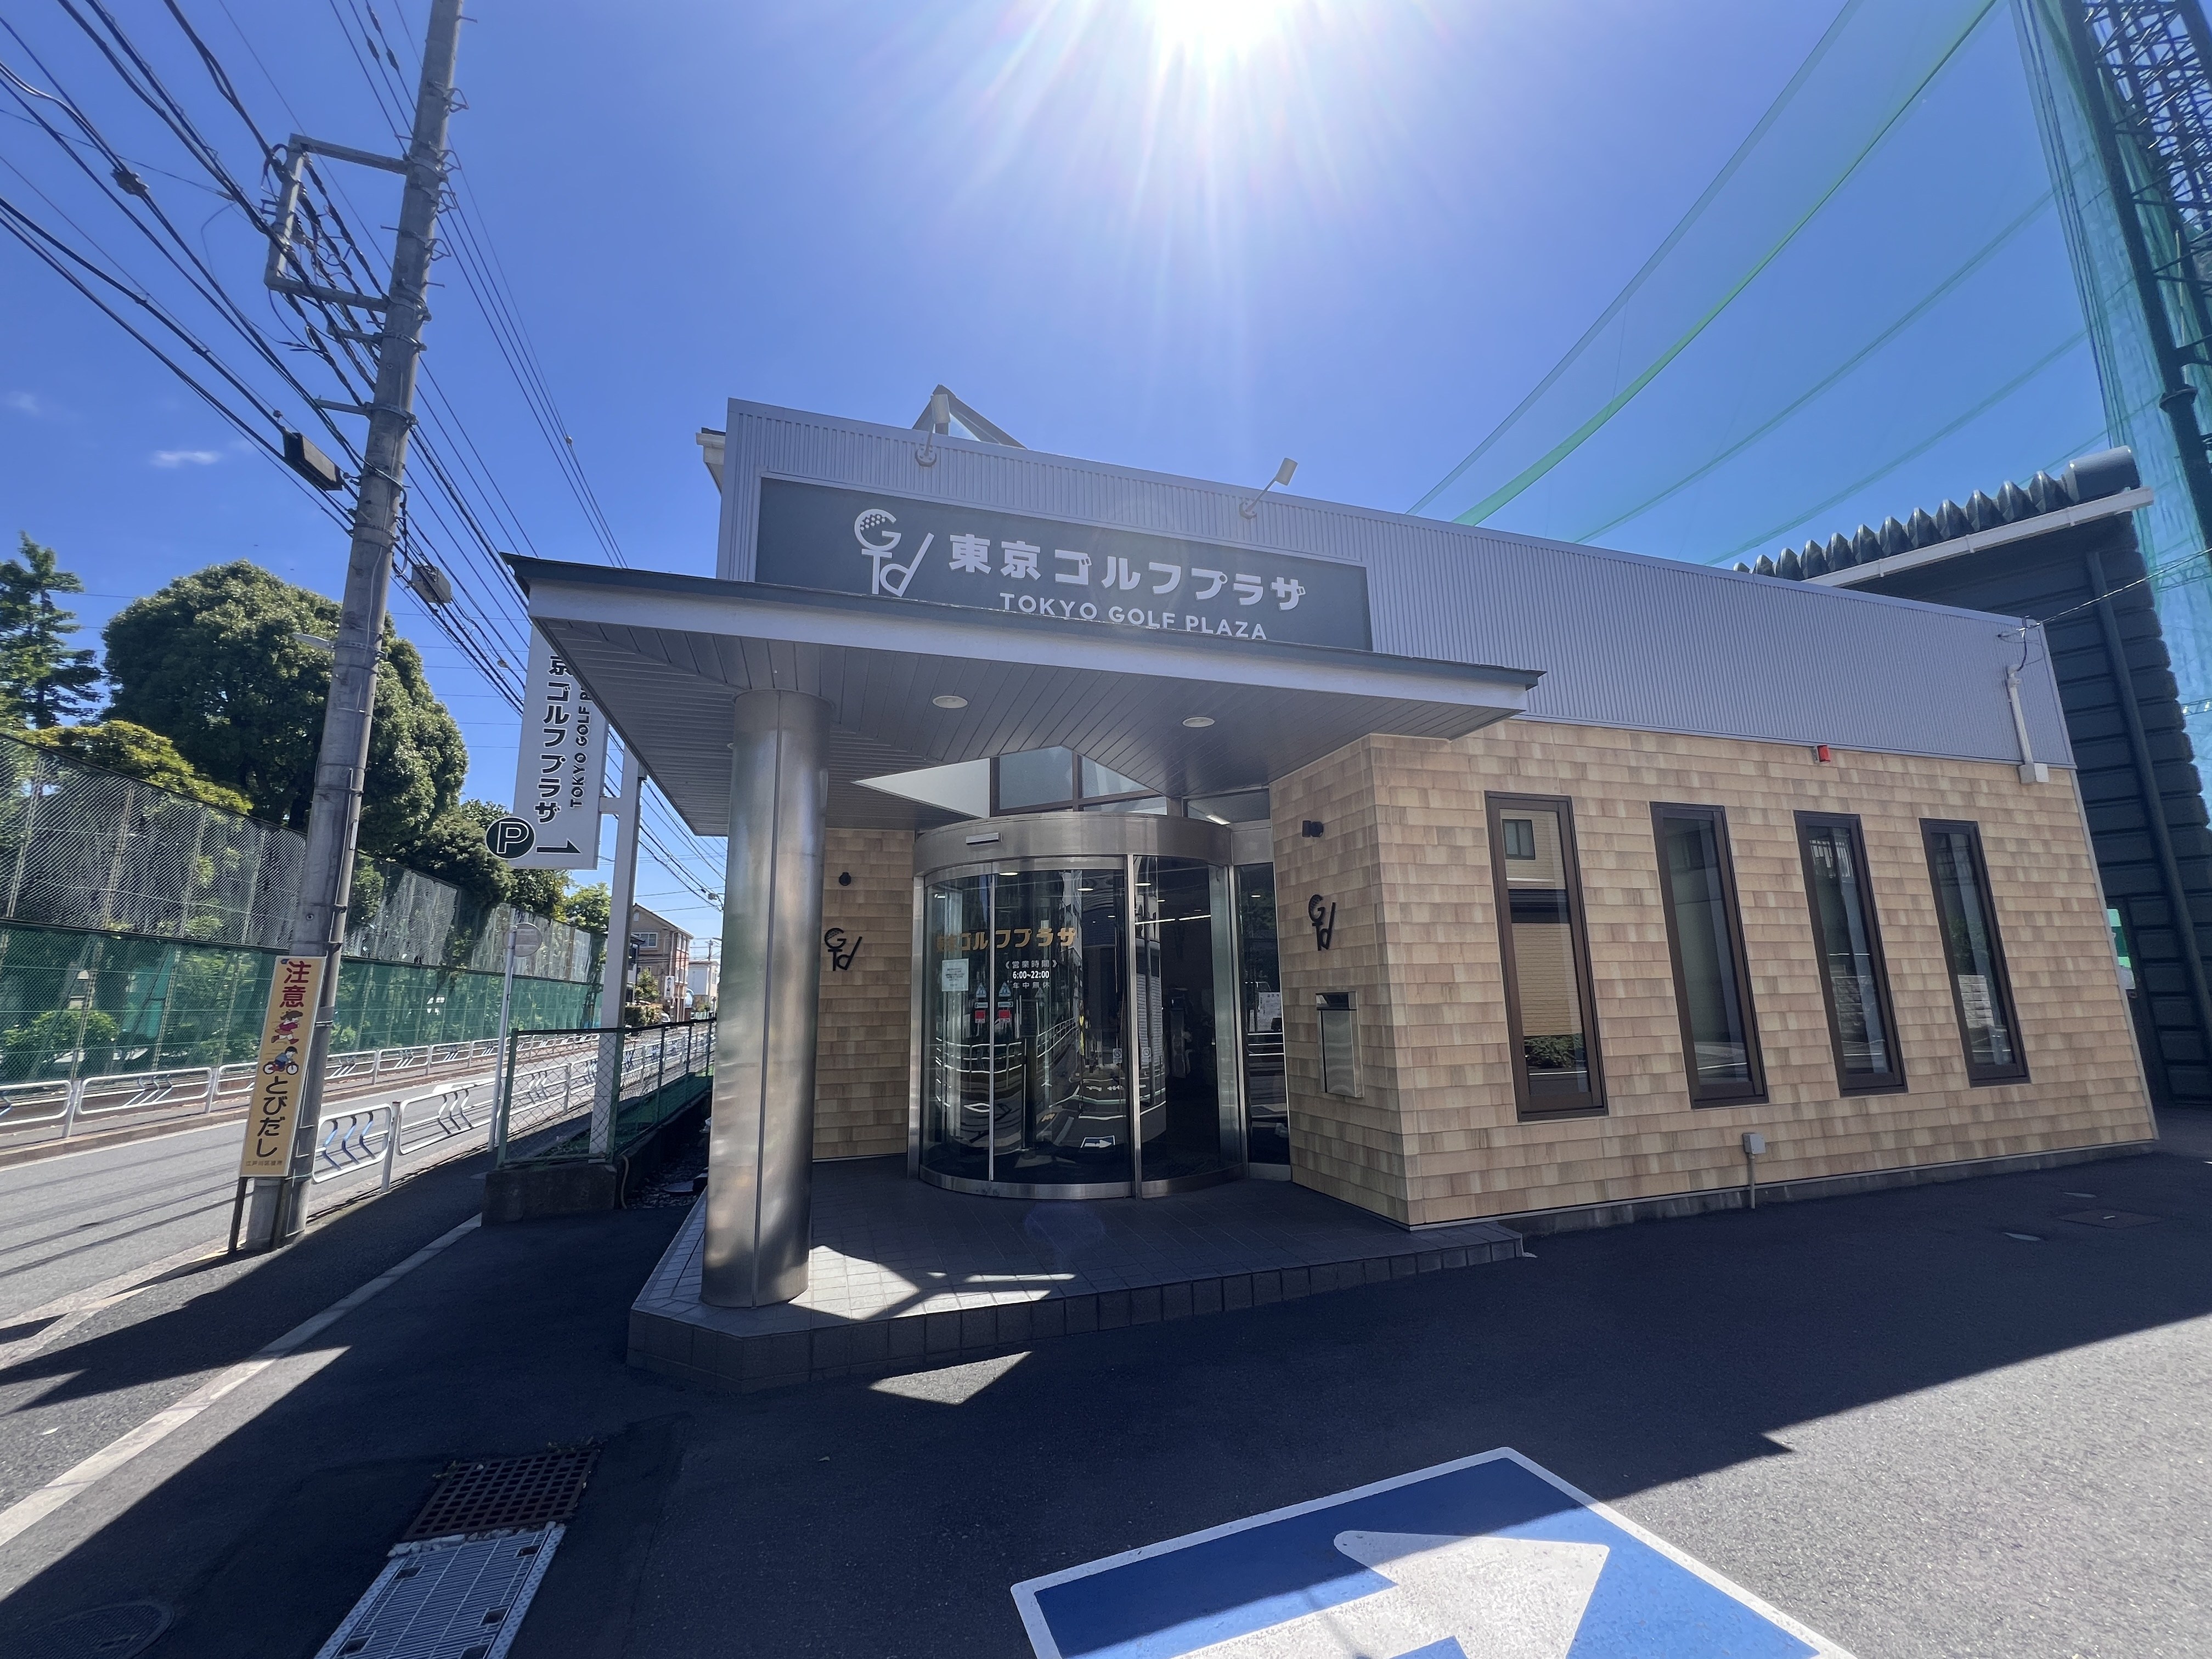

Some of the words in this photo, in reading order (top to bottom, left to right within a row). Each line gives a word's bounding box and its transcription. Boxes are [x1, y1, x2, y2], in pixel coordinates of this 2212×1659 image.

[949, 534, 1306, 611] 東京ゴルフプラザ
[1000, 592, 1097, 620] TOKYO
[1108, 606, 1176, 629] GOLF
[1186, 615, 1267, 640] PLAZA
[575, 705, 591, 747] GOLF
[570, 752, 587, 809] TOKYO
[279, 961, 311, 1008] 注意
[256, 1075, 288, 1158] とびだし
